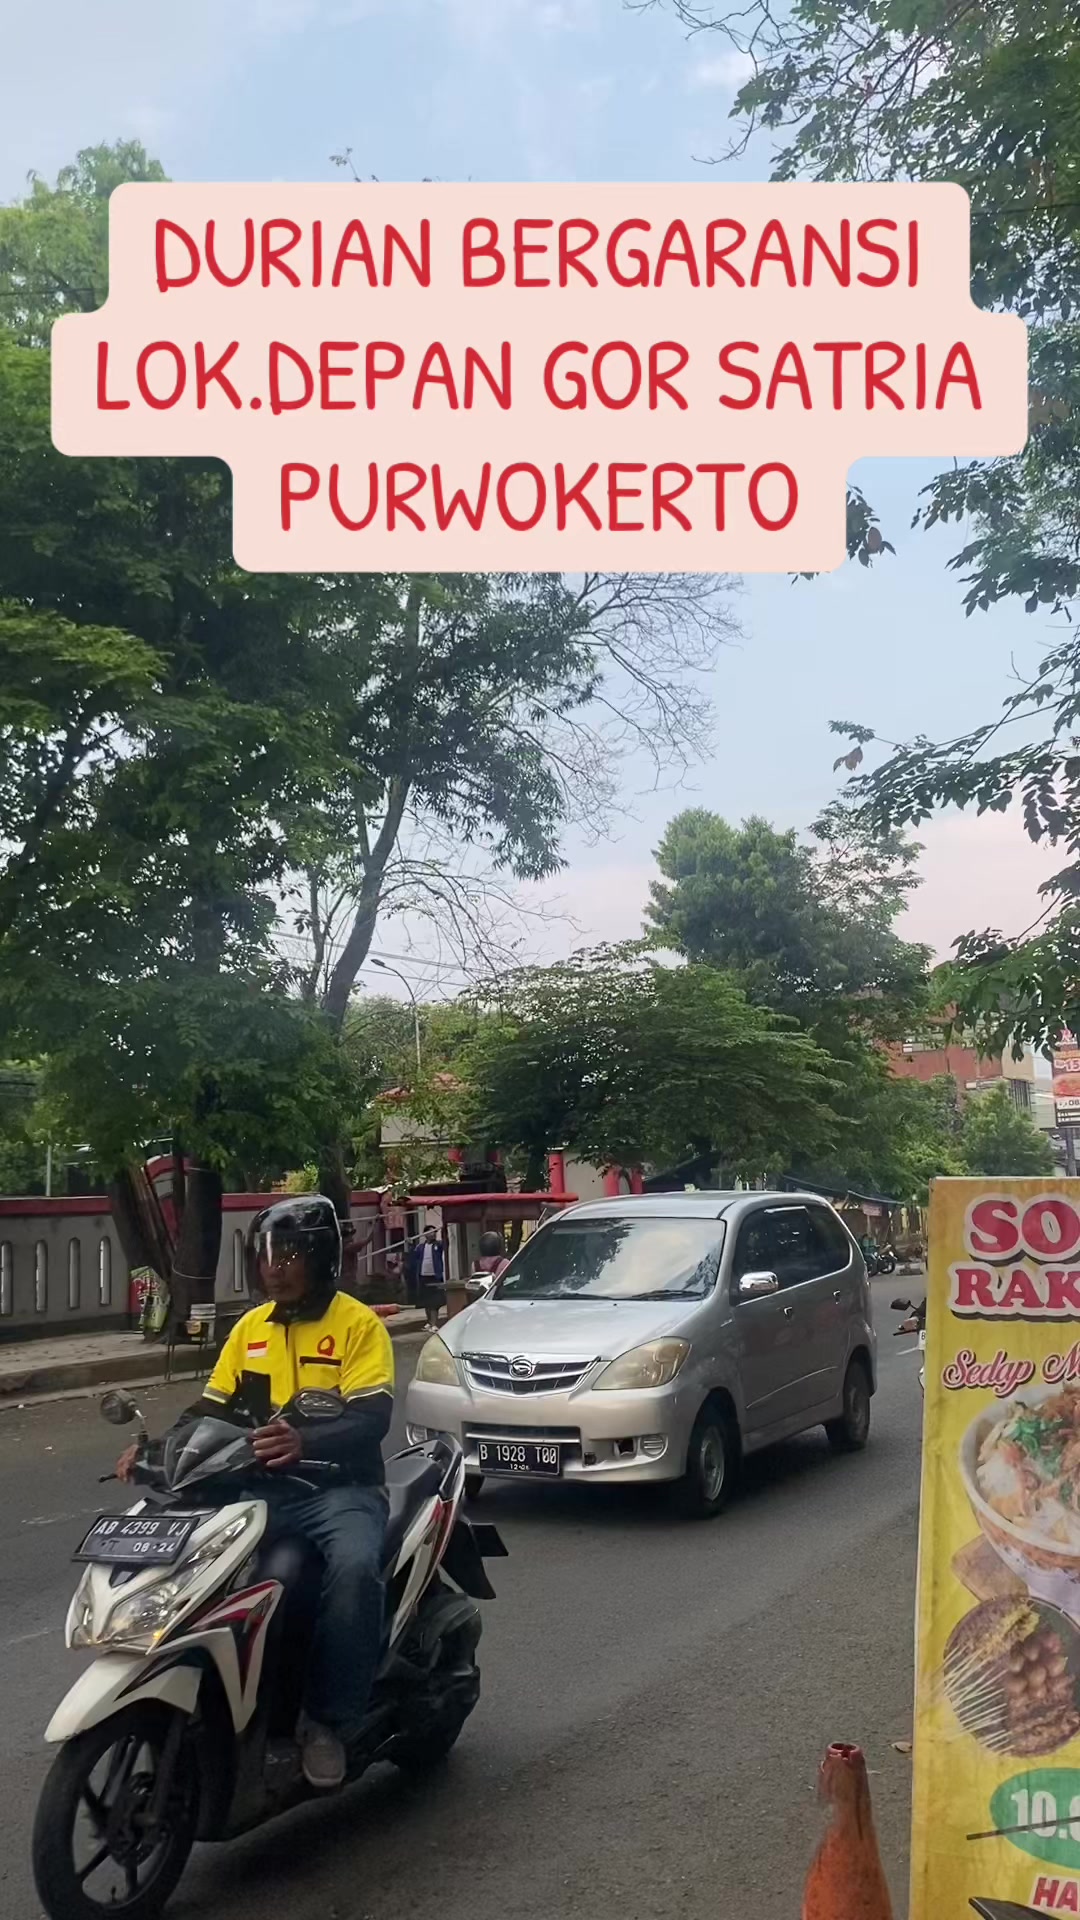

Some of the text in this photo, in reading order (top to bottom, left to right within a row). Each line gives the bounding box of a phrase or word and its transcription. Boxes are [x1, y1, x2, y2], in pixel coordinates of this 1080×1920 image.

[943, 1349, 1034, 1396] Sedap
[480, 1444, 488, 1460] B
[496, 1445, 526, 1462] 1928
[94, 1520, 119, 1535] AB
[120, 1520, 161, 1535] 4399
